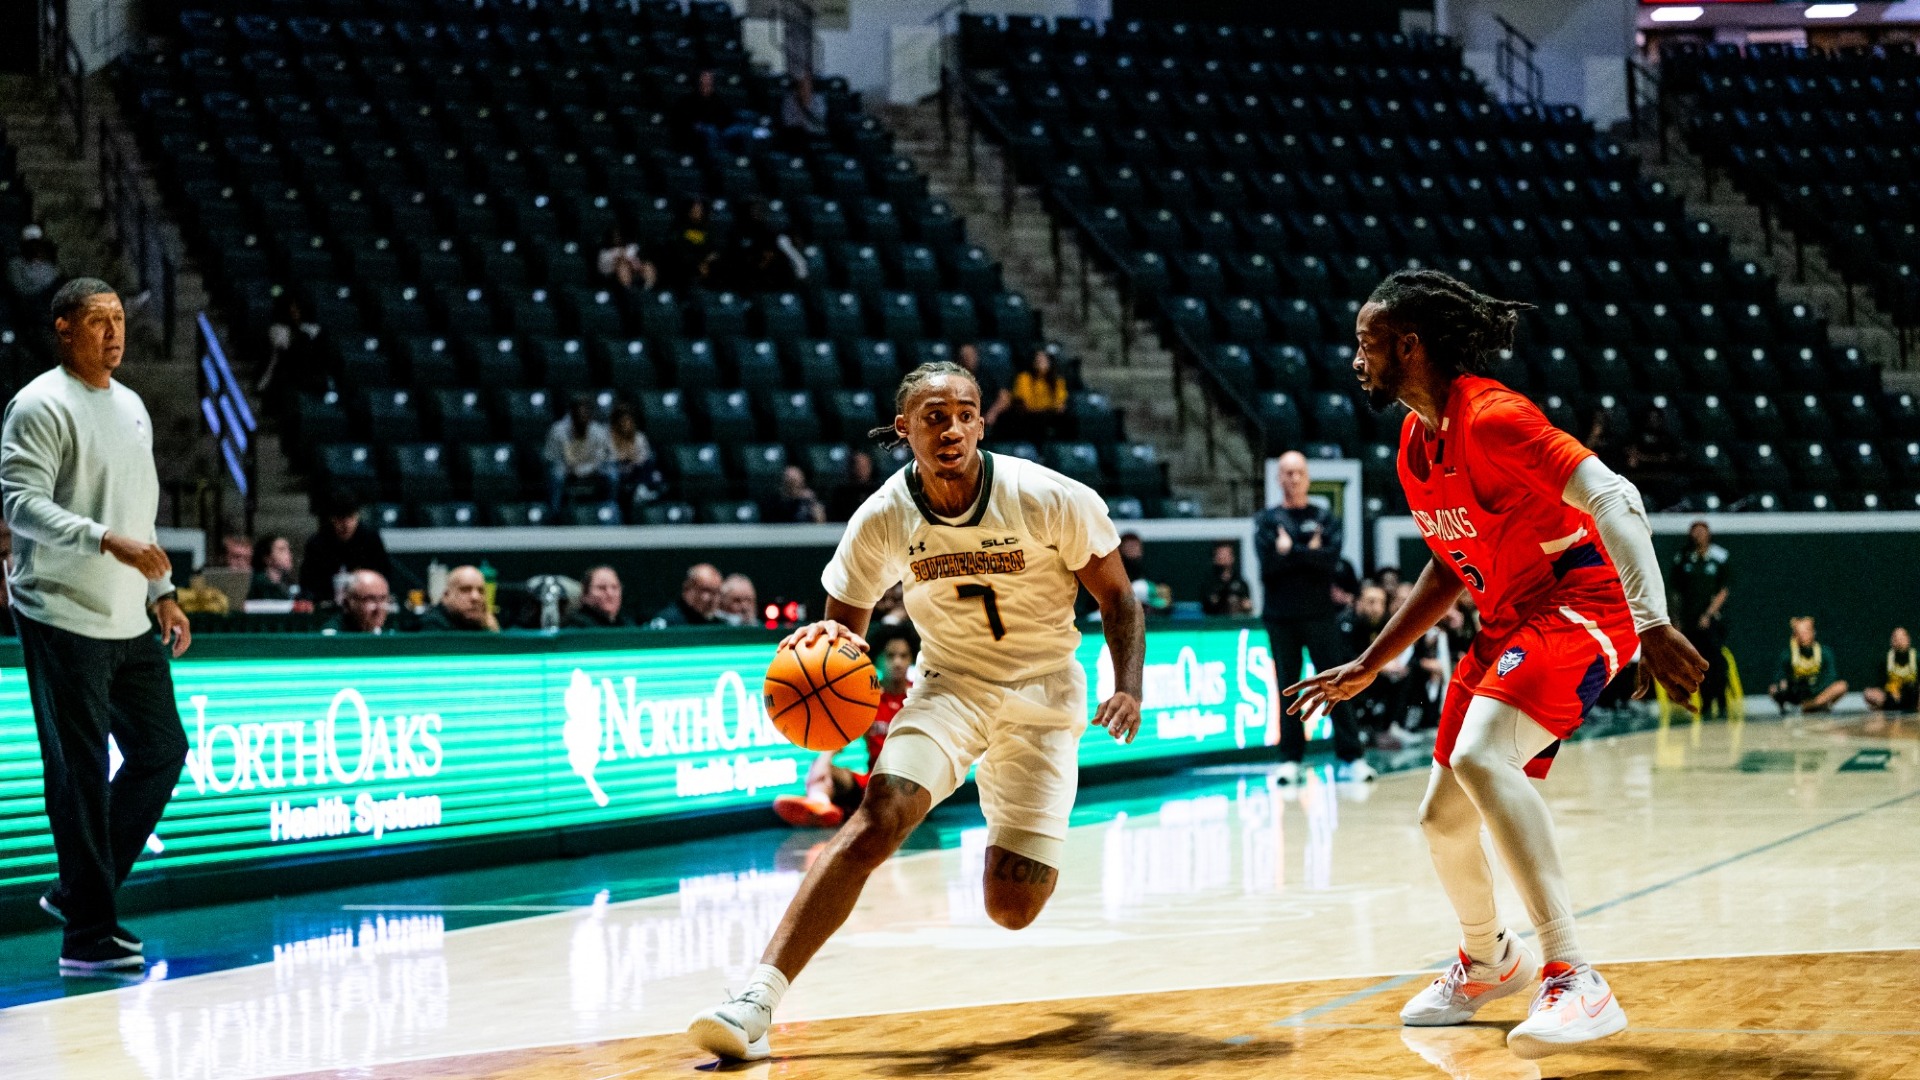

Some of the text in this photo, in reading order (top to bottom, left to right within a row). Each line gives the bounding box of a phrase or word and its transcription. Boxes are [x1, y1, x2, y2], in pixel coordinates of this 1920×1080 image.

[910, 549, 1026, 582] SOUTHEASTERN
[953, 583, 1007, 641] 7
[270, 792, 442, 841] Health System
